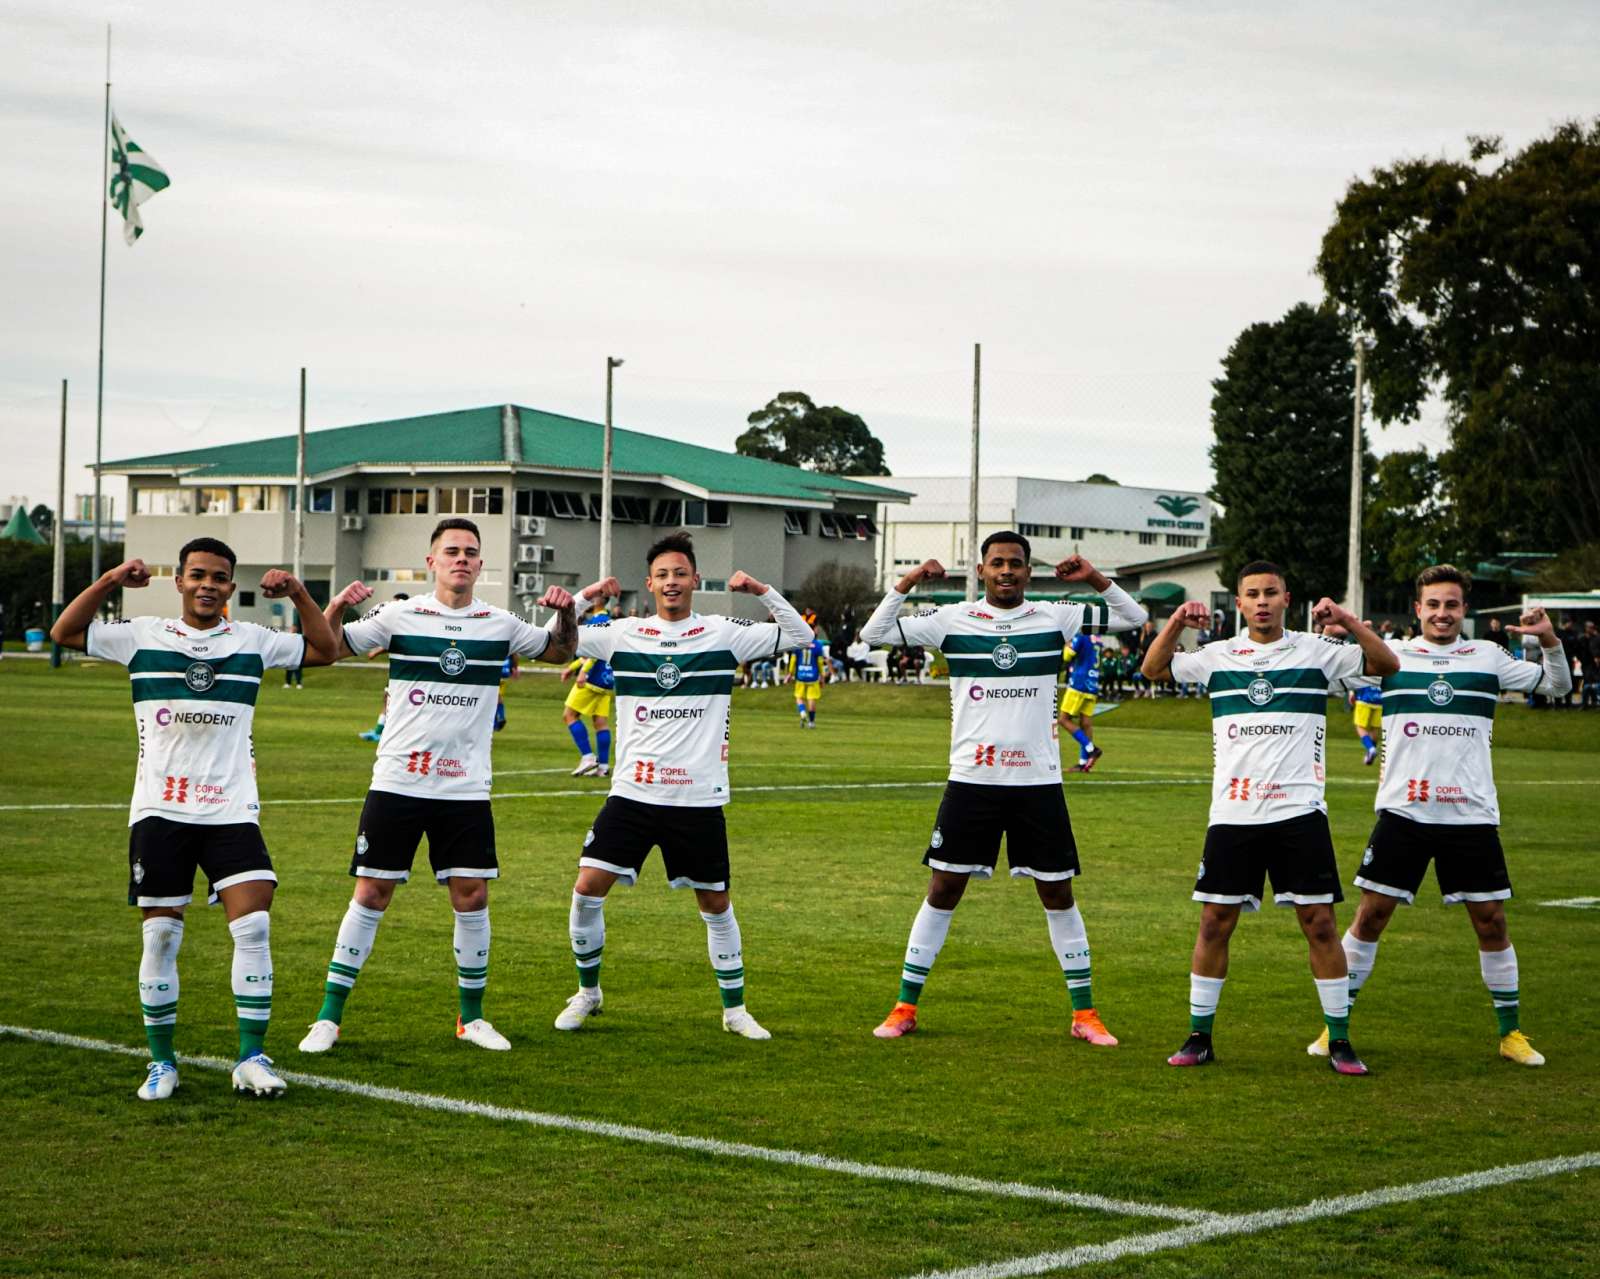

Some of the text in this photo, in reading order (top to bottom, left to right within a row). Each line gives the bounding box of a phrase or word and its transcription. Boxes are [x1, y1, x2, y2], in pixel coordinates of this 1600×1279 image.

[986, 687, 1039, 699] NEODENT
[427, 694, 480, 707] NEODENT
[174, 712, 236, 726] NEODENT
[650, 708, 705, 719] NEODENT
[1240, 725, 1295, 736] NEODENT
[1422, 725, 1477, 737] NEODENT
[436, 758, 462, 768] COPEL
[436, 768, 467, 777] Telecom
[660, 767, 688, 776] COPEL
[660, 776, 693, 785] Telecom
[195, 783, 225, 794] COPEL
[1435, 786, 1464, 794] COPEL
